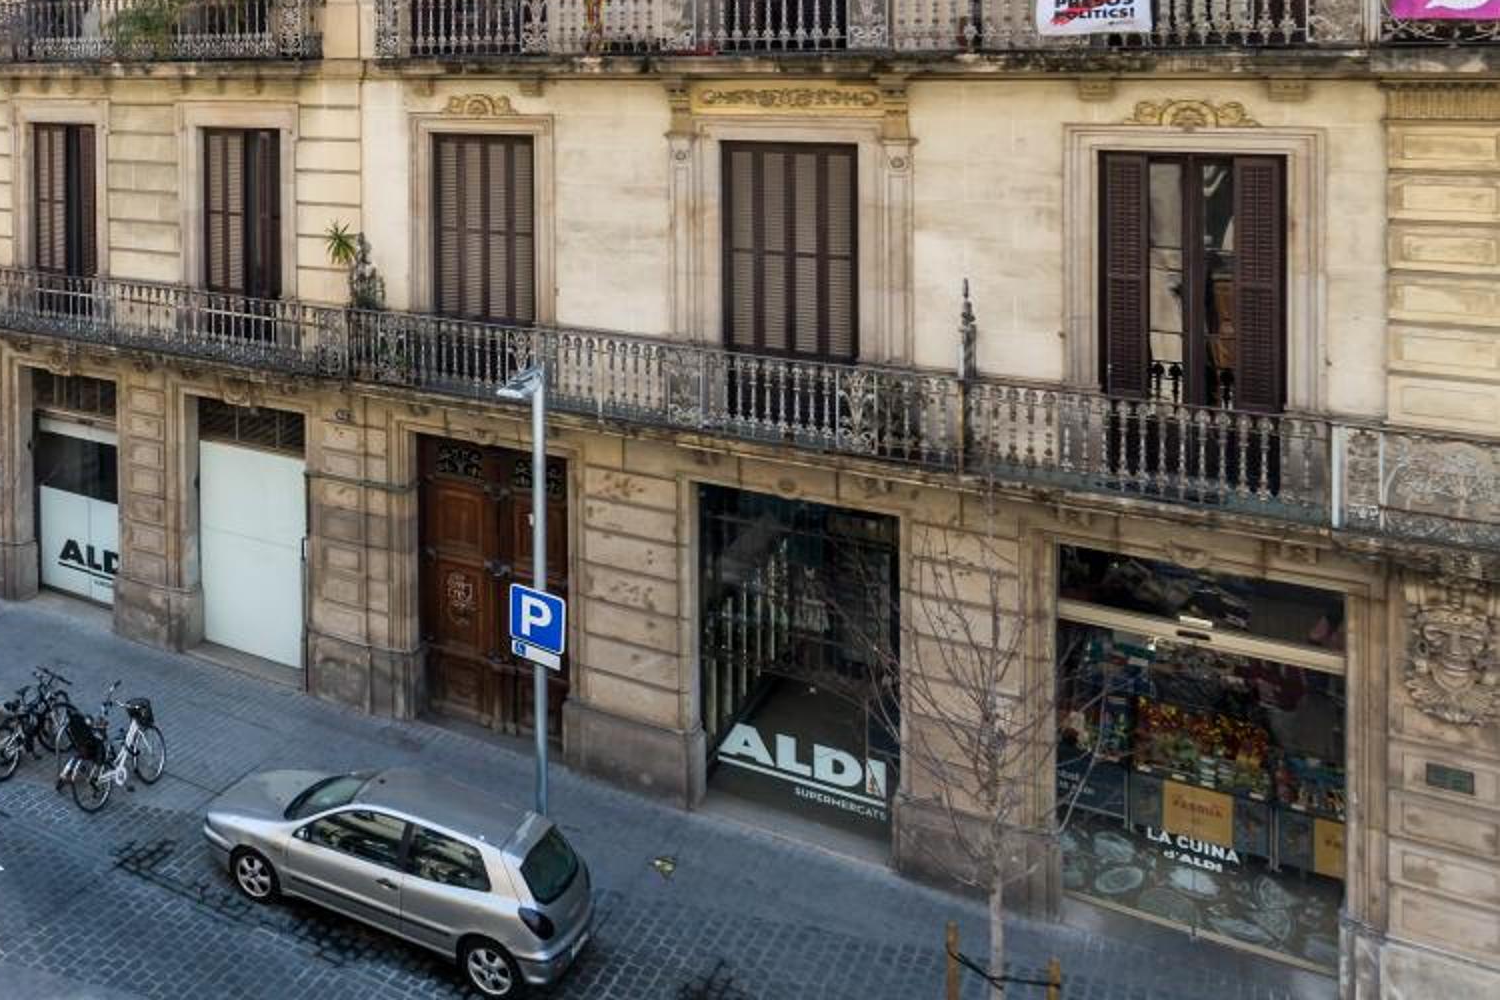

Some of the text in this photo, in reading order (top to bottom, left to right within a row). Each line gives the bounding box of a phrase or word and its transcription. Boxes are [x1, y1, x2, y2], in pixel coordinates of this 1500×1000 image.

[521, 593, 553, 637] P
[717, 722, 888, 799] ALDI
[794, 785, 888, 821] SUPERMERCATS
[1146, 826, 1240, 865] LA CUINA
[1163, 849, 1224, 873] d'ALDI
